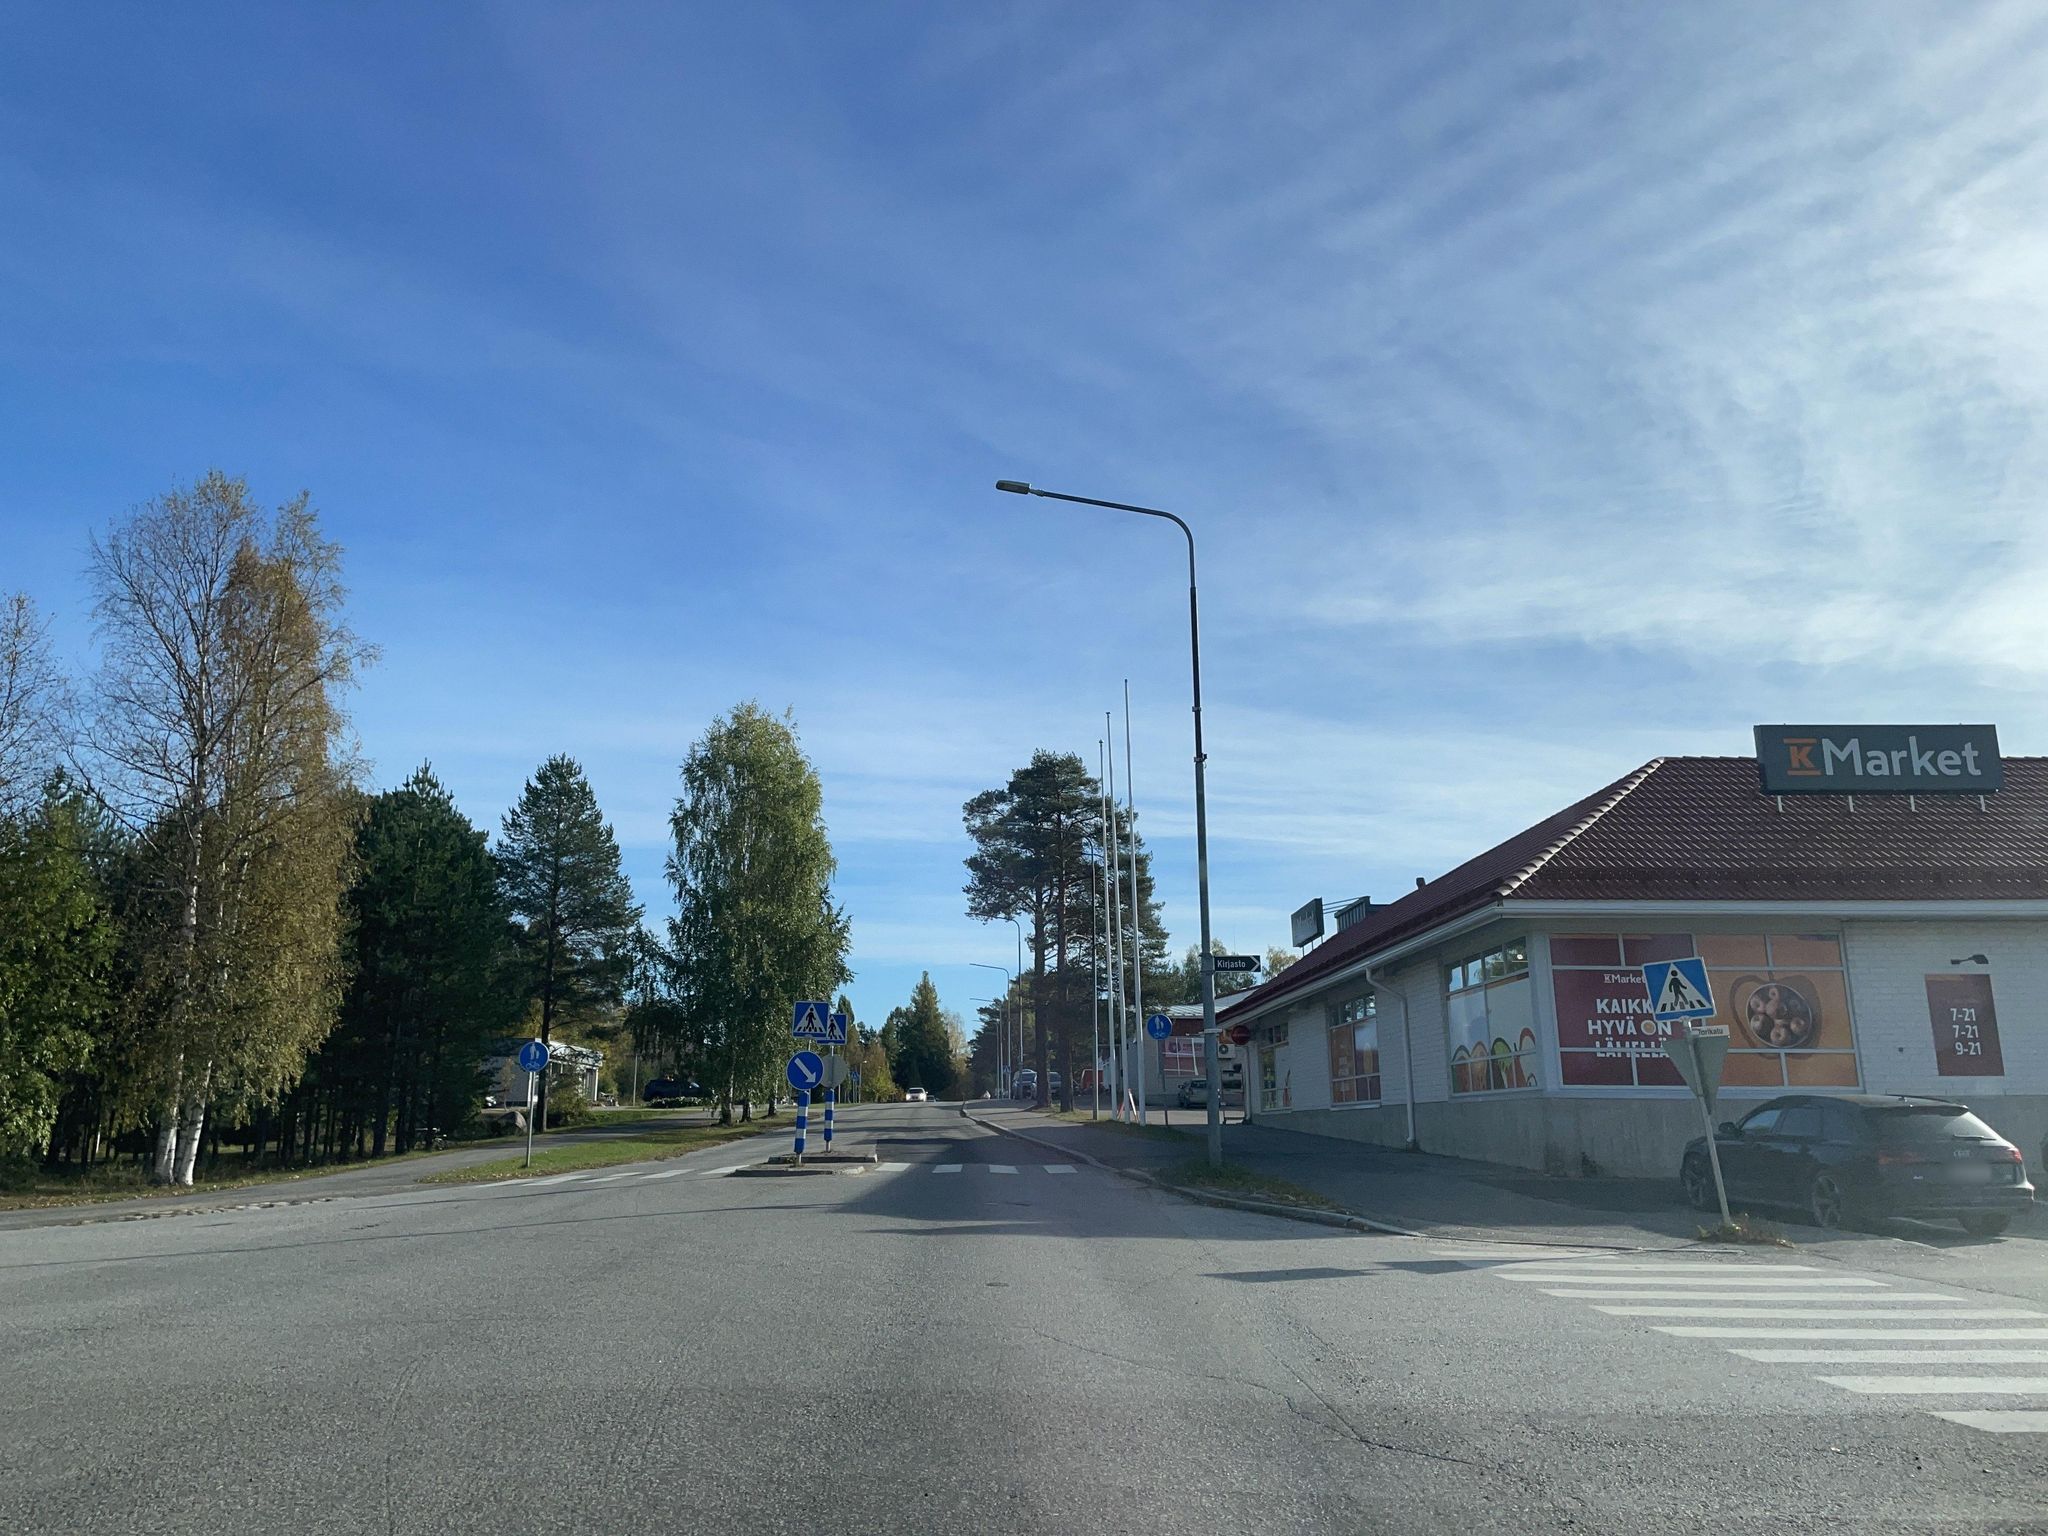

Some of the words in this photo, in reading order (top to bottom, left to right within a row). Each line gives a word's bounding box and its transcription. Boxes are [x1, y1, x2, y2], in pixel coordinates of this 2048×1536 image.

[1217, 959, 1246, 969] Kirjasto
[1596, 998, 1654, 1014] KAIKK
[1950, 1007, 1976, 1021] 7-21
[1587, 1016, 1637, 1035] HYVÄ
[1641, 1019, 1672, 1036] ON
[1952, 1025, 1979, 1038] 7-21
[1955, 1042, 1982, 1055] 9-21
